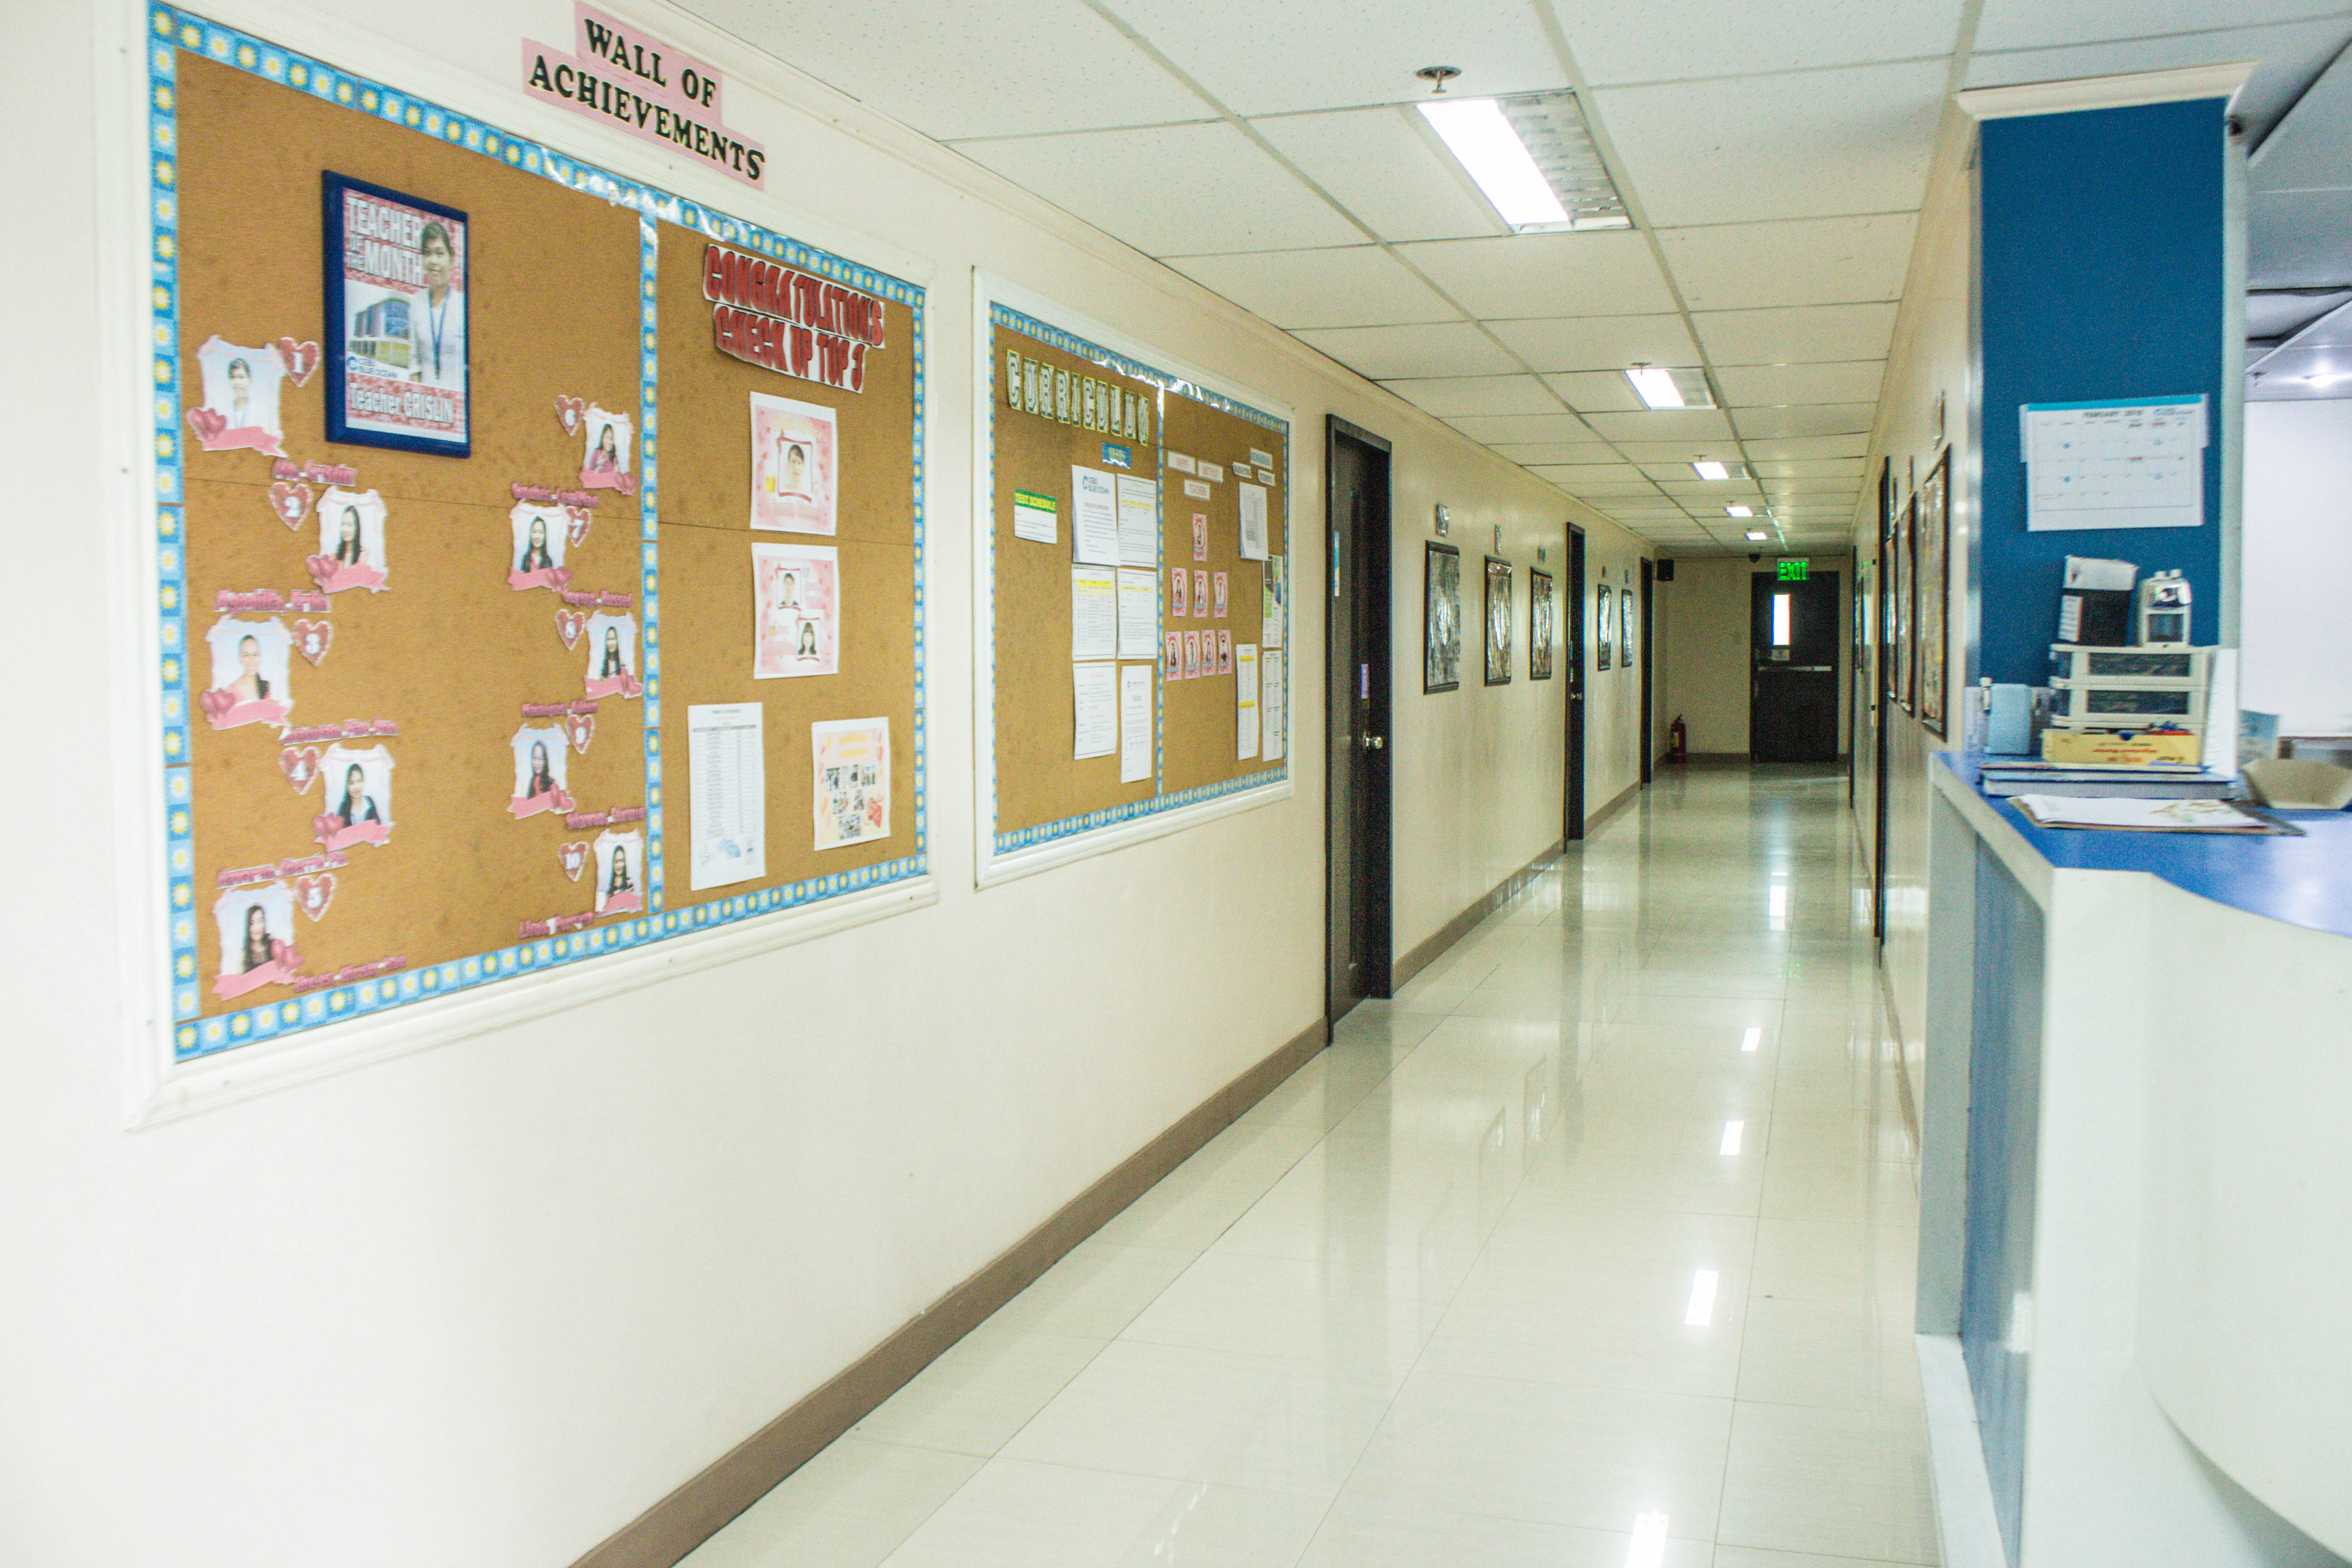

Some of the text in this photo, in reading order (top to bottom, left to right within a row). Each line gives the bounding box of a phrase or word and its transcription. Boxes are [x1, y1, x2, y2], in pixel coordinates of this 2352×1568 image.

[584, 19, 716, 108] WALL OF
[529, 54, 765, 181] ACHIEVEMENTS
[347, 196, 423, 250] TEACHER
[364, 239, 425, 287] MONTH
[705, 245, 883, 346] CONGRATULATIONS
[292, 352, 303, 374] 1
[817, 332, 850, 387] TOP
[348, 382, 402, 416] Teacher
[1006, 349, 1149, 446] CURRICULUM
[284, 496, 301, 517] 2
[573, 519, 584, 539] 7
[1778, 561, 1808, 580] EXIT
[305, 633, 320, 655] 3
[574, 726, 586, 744] 9
[290, 760, 308, 781] 4
[565, 853, 579, 870] 10
